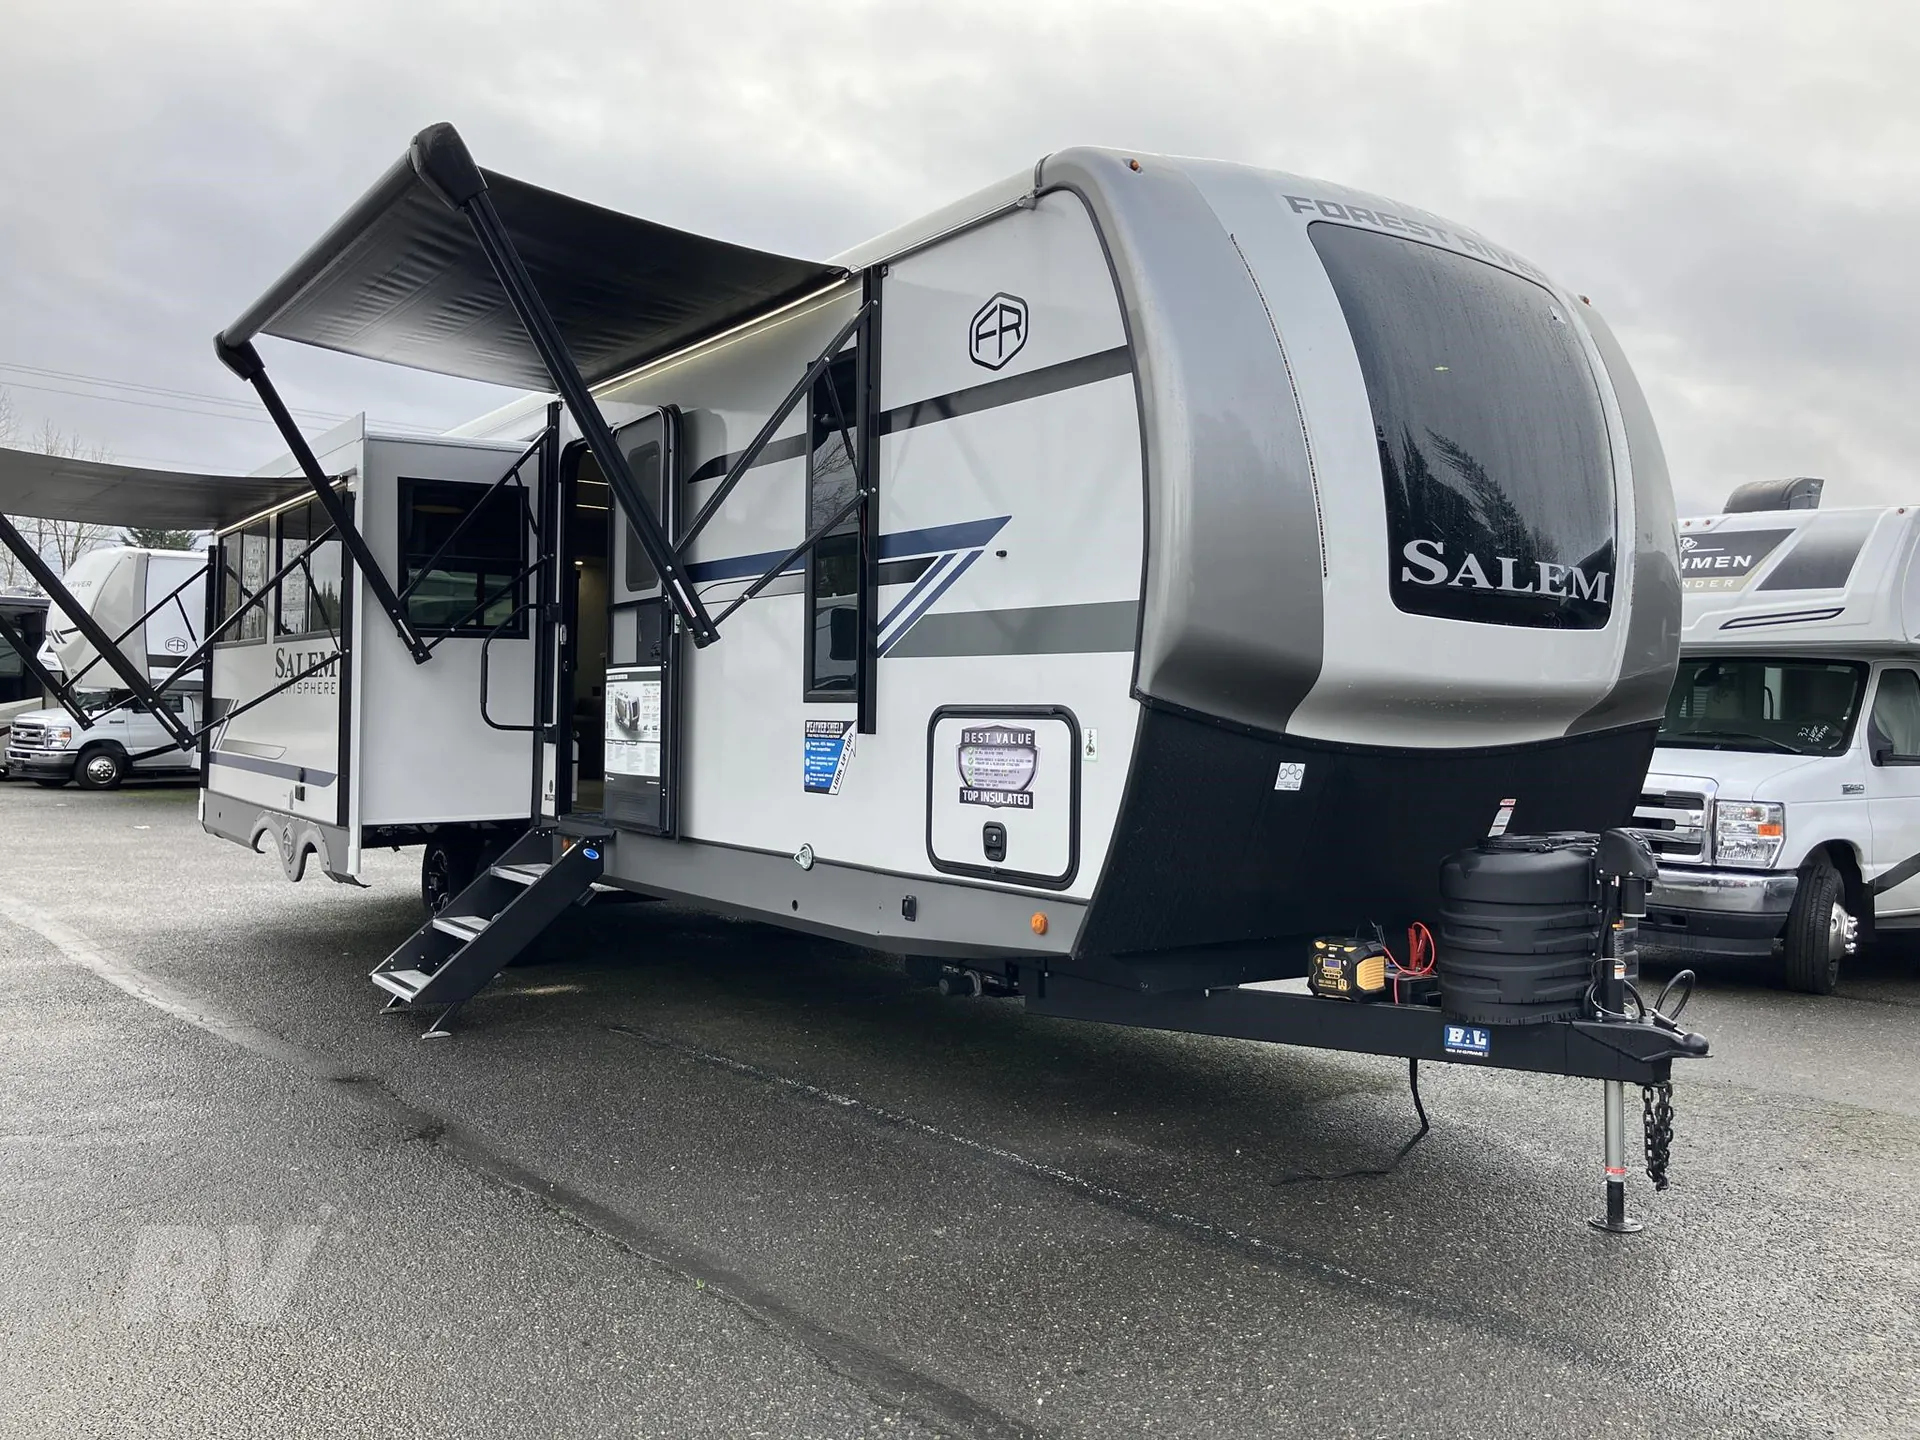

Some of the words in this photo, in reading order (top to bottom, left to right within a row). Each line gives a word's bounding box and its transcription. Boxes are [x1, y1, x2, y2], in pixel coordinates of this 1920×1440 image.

[1281, 194, 1449, 243] FOREST
[1454, 233, 1554, 289] RIVER
[1401, 539, 1610, 604] SALEM
[275, 646, 338, 679] SALEM
[964, 731, 991, 743] BEST
[996, 732, 1032, 745] VALUE
[962, 789, 979, 802] TOP
[980, 791, 1030, 806] INSULATED
